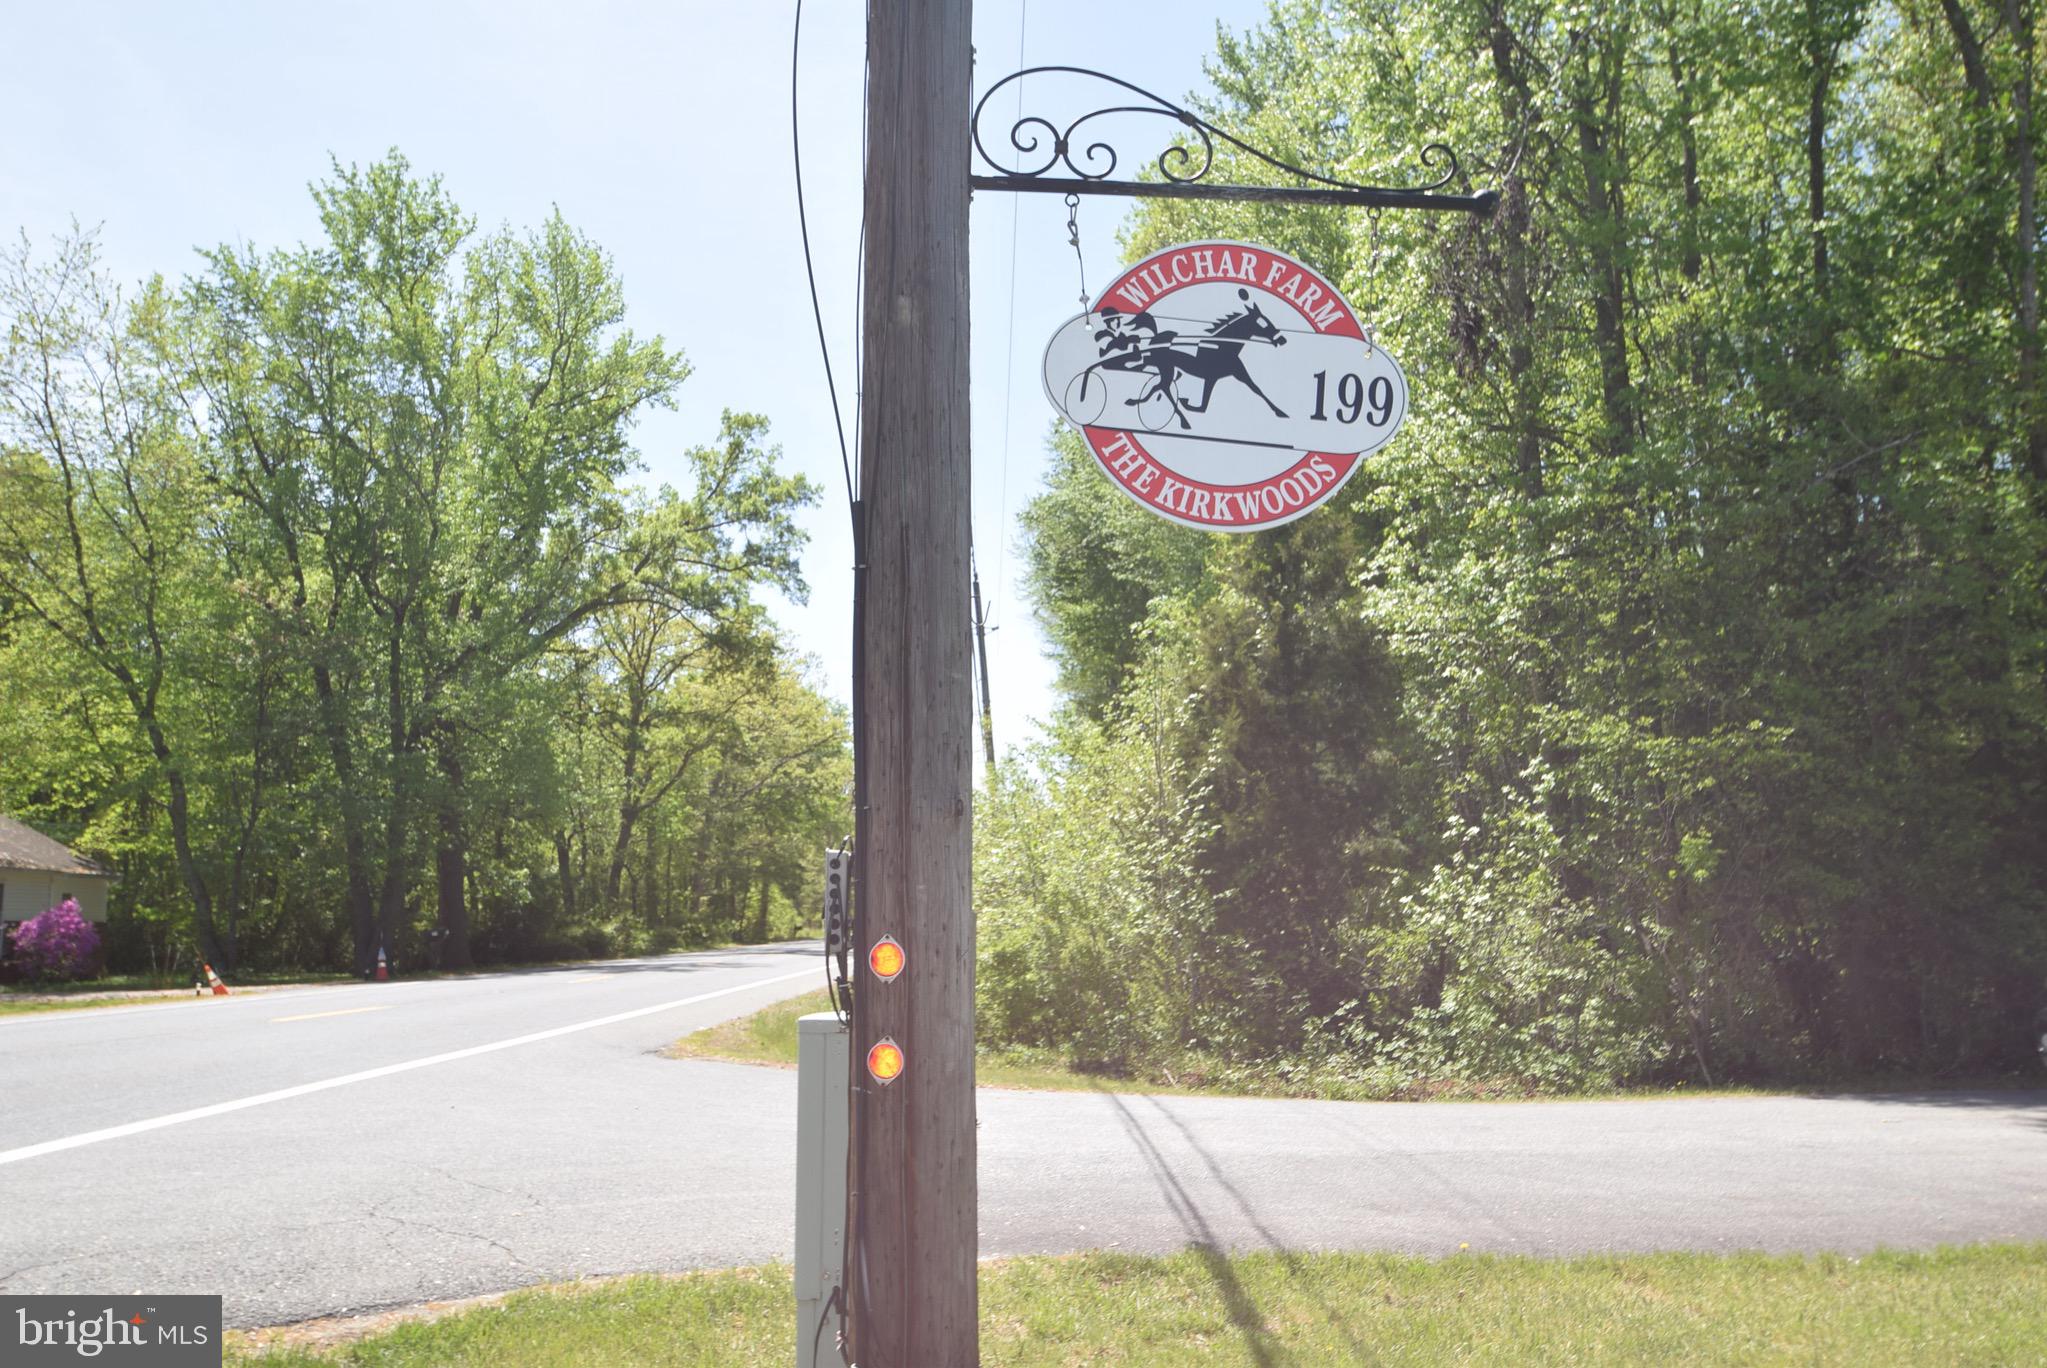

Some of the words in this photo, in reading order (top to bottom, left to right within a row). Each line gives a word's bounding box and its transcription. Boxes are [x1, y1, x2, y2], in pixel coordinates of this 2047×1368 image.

[1116, 249, 1258, 310] WILCHAR
[1263, 260, 1344, 332] FARM
[1310, 369, 1394, 427] 199
[1101, 432, 1151, 494] THE
[1155, 455, 1337, 521] KIRKWOODS
